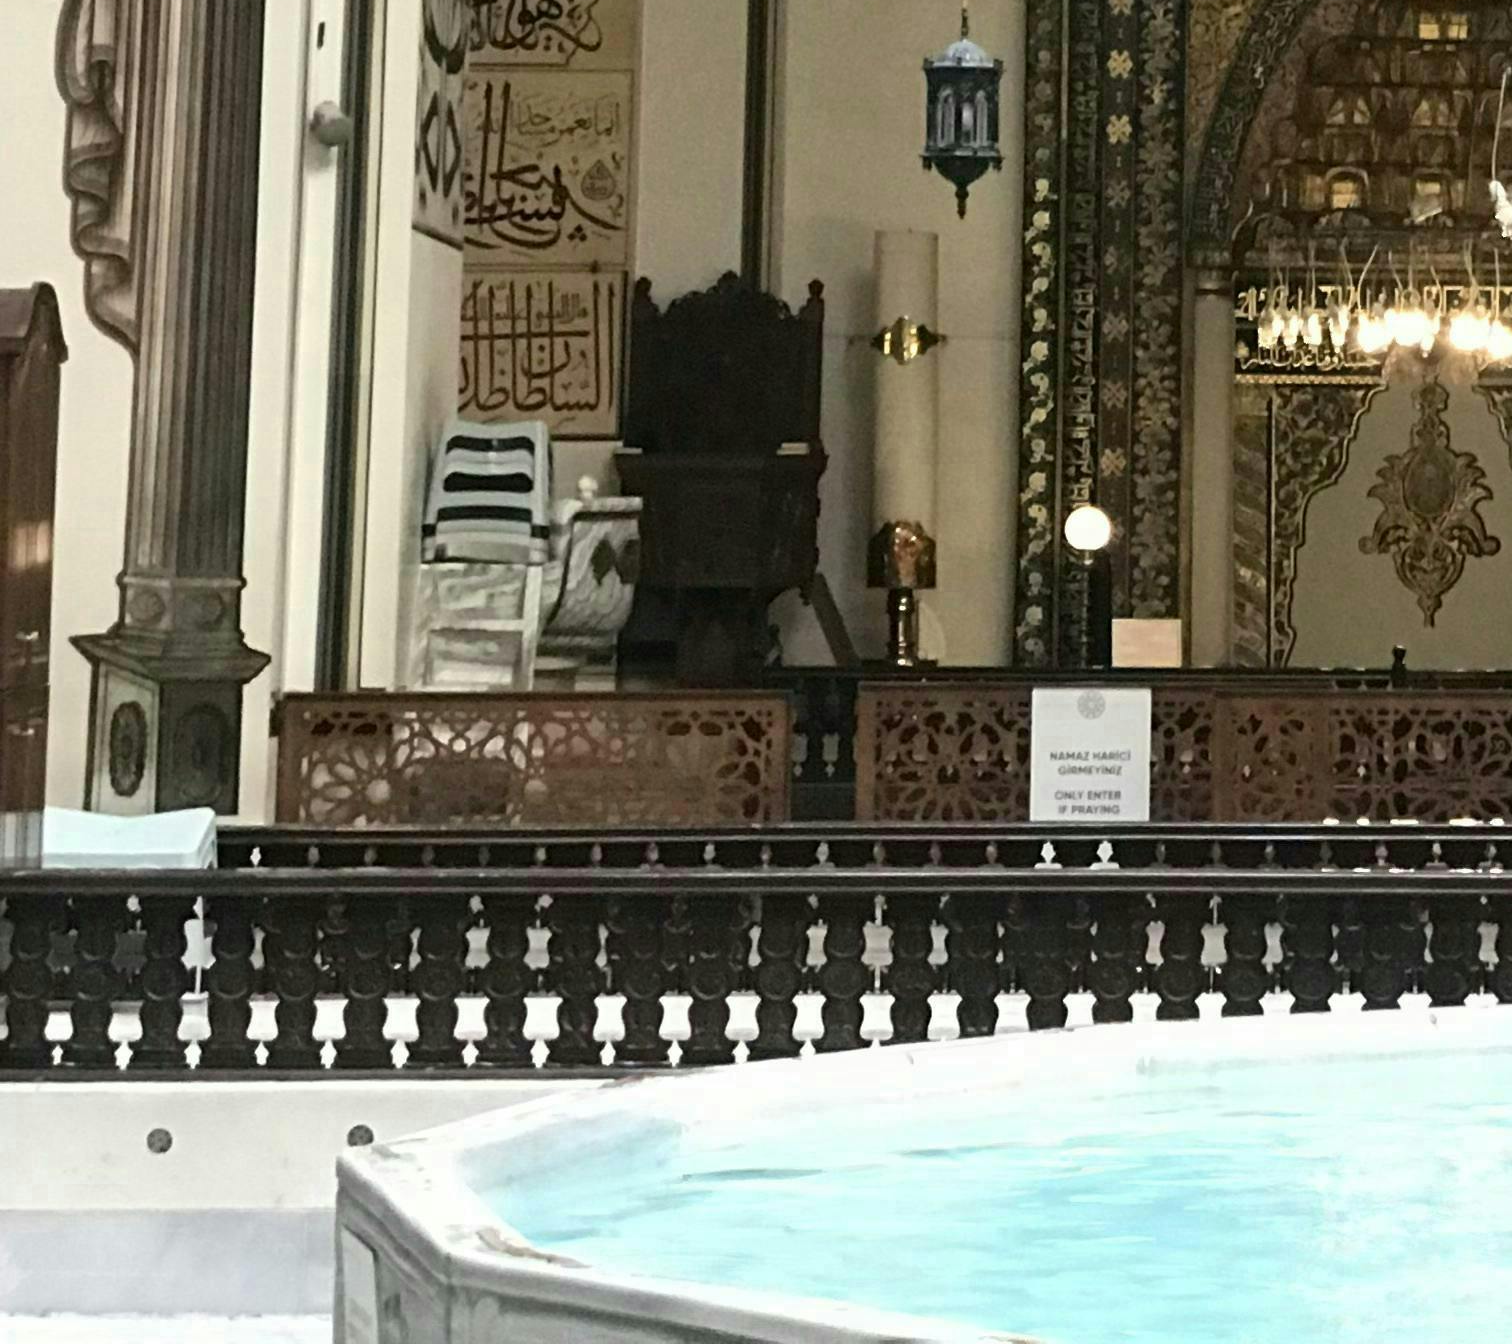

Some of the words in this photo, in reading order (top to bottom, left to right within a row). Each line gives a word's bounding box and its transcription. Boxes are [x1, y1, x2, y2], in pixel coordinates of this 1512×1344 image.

[1050, 751, 1090, 761] NAMAZ
[1055, 790, 1083, 800] ONLY
[1087, 790, 1121, 800] ENTER
[1058, 805, 1068, 814] IF
[1071, 804, 1120, 814] PRAYING
